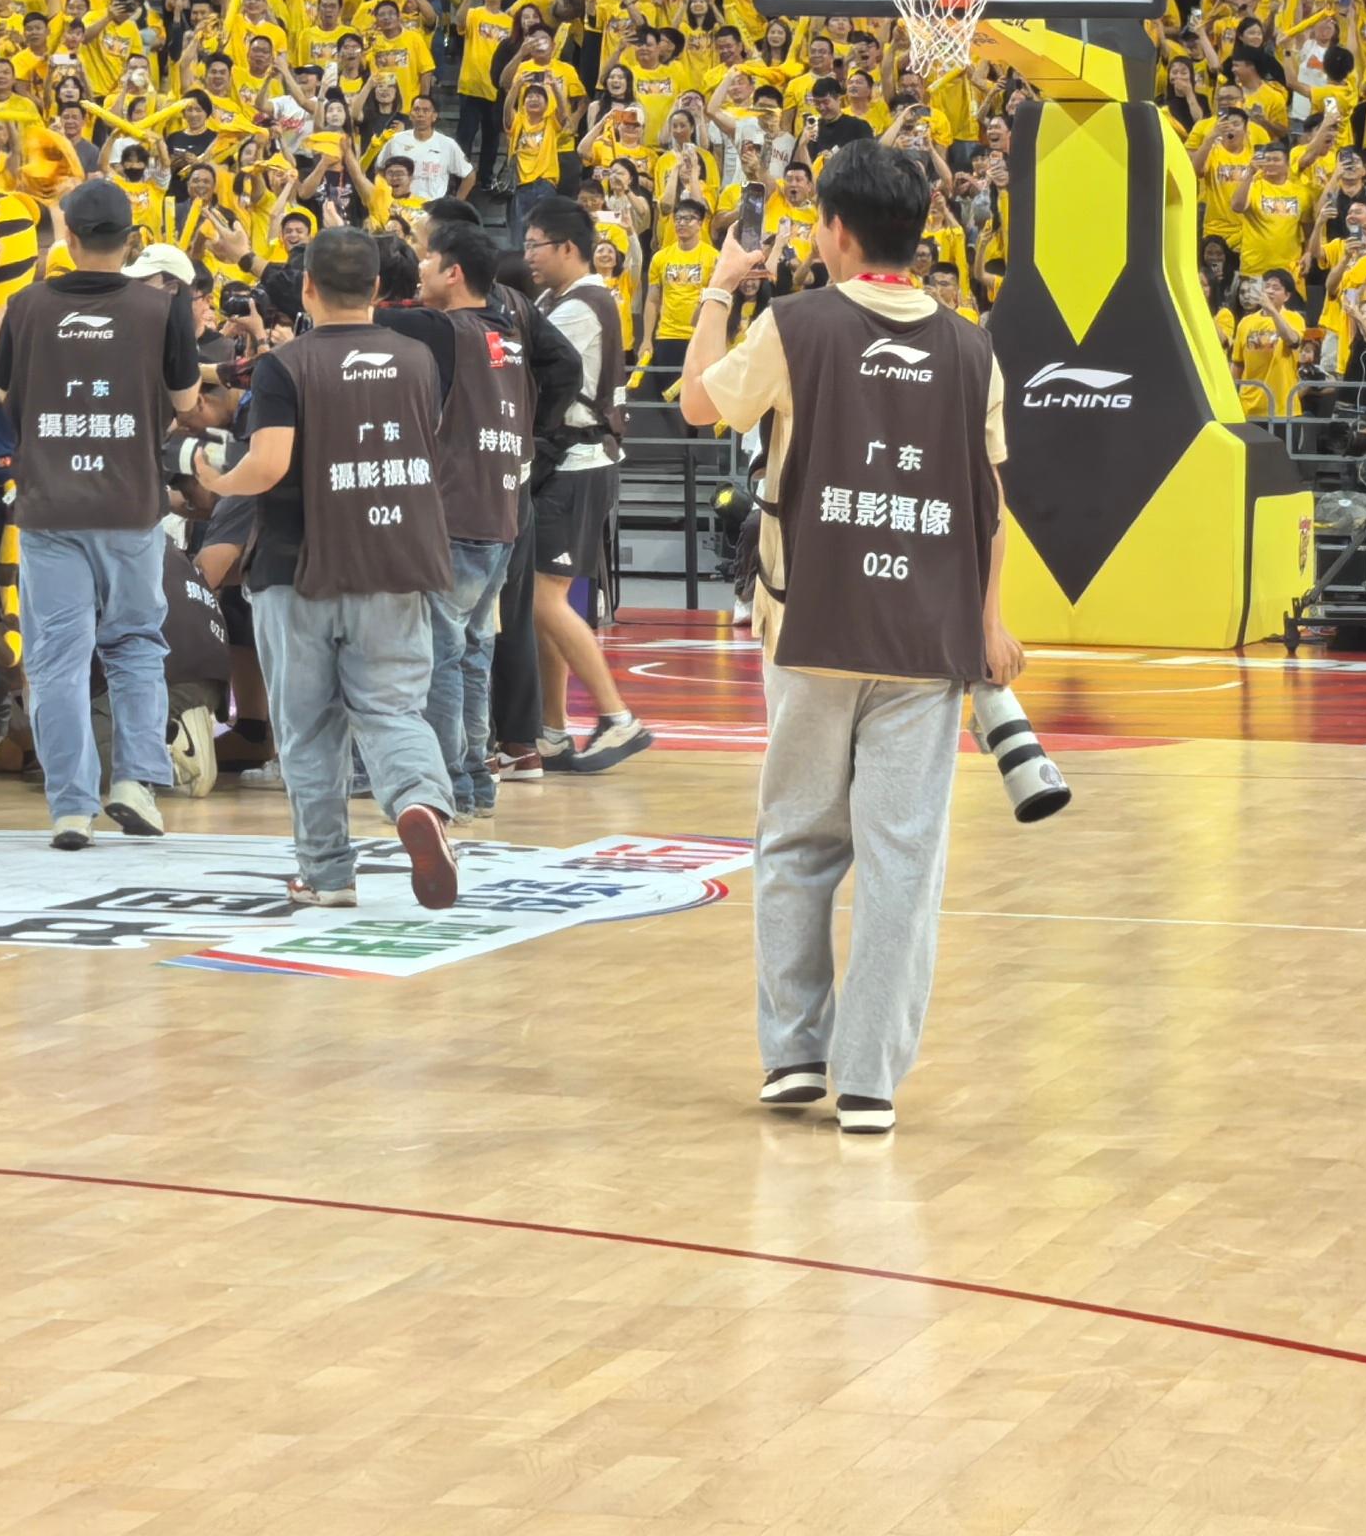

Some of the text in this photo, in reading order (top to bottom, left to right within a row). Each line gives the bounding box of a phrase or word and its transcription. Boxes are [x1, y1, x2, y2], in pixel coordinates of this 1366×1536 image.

[57, 329, 114, 340] LI-NING
[343, 367, 398, 381] LI-NING
[860, 362, 933, 383] LI-NING
[65, 379, 110, 398] 广东
[1023, 392, 1133, 409] LI-NING
[38, 412, 136, 439] 摄影摄像
[357, 421, 401, 445] 广东
[71, 454, 104, 472] 014
[865, 439, 924, 472] 广东
[329, 457, 431, 491] 摄影摄像
[367, 505, 403, 526] 024
[820, 485, 952, 536] 摄影摄像
[863, 552, 909, 580] 026
